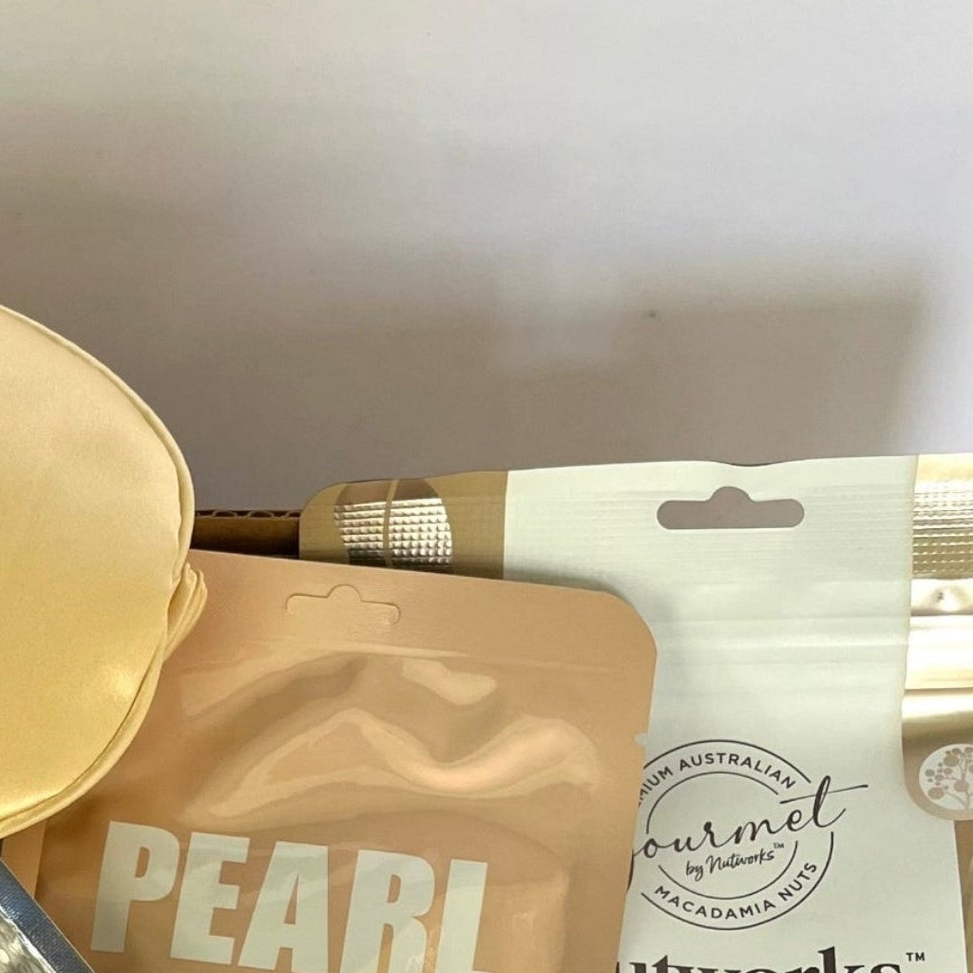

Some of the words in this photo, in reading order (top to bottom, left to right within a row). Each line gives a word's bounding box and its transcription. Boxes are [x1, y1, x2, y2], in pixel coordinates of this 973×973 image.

[679, 753, 796, 789] AUSTRALIAN
[686, 860, 704, 882] by
[655, 885, 776, 920] MACADAMIA
[778, 862, 817, 901] NUTS
